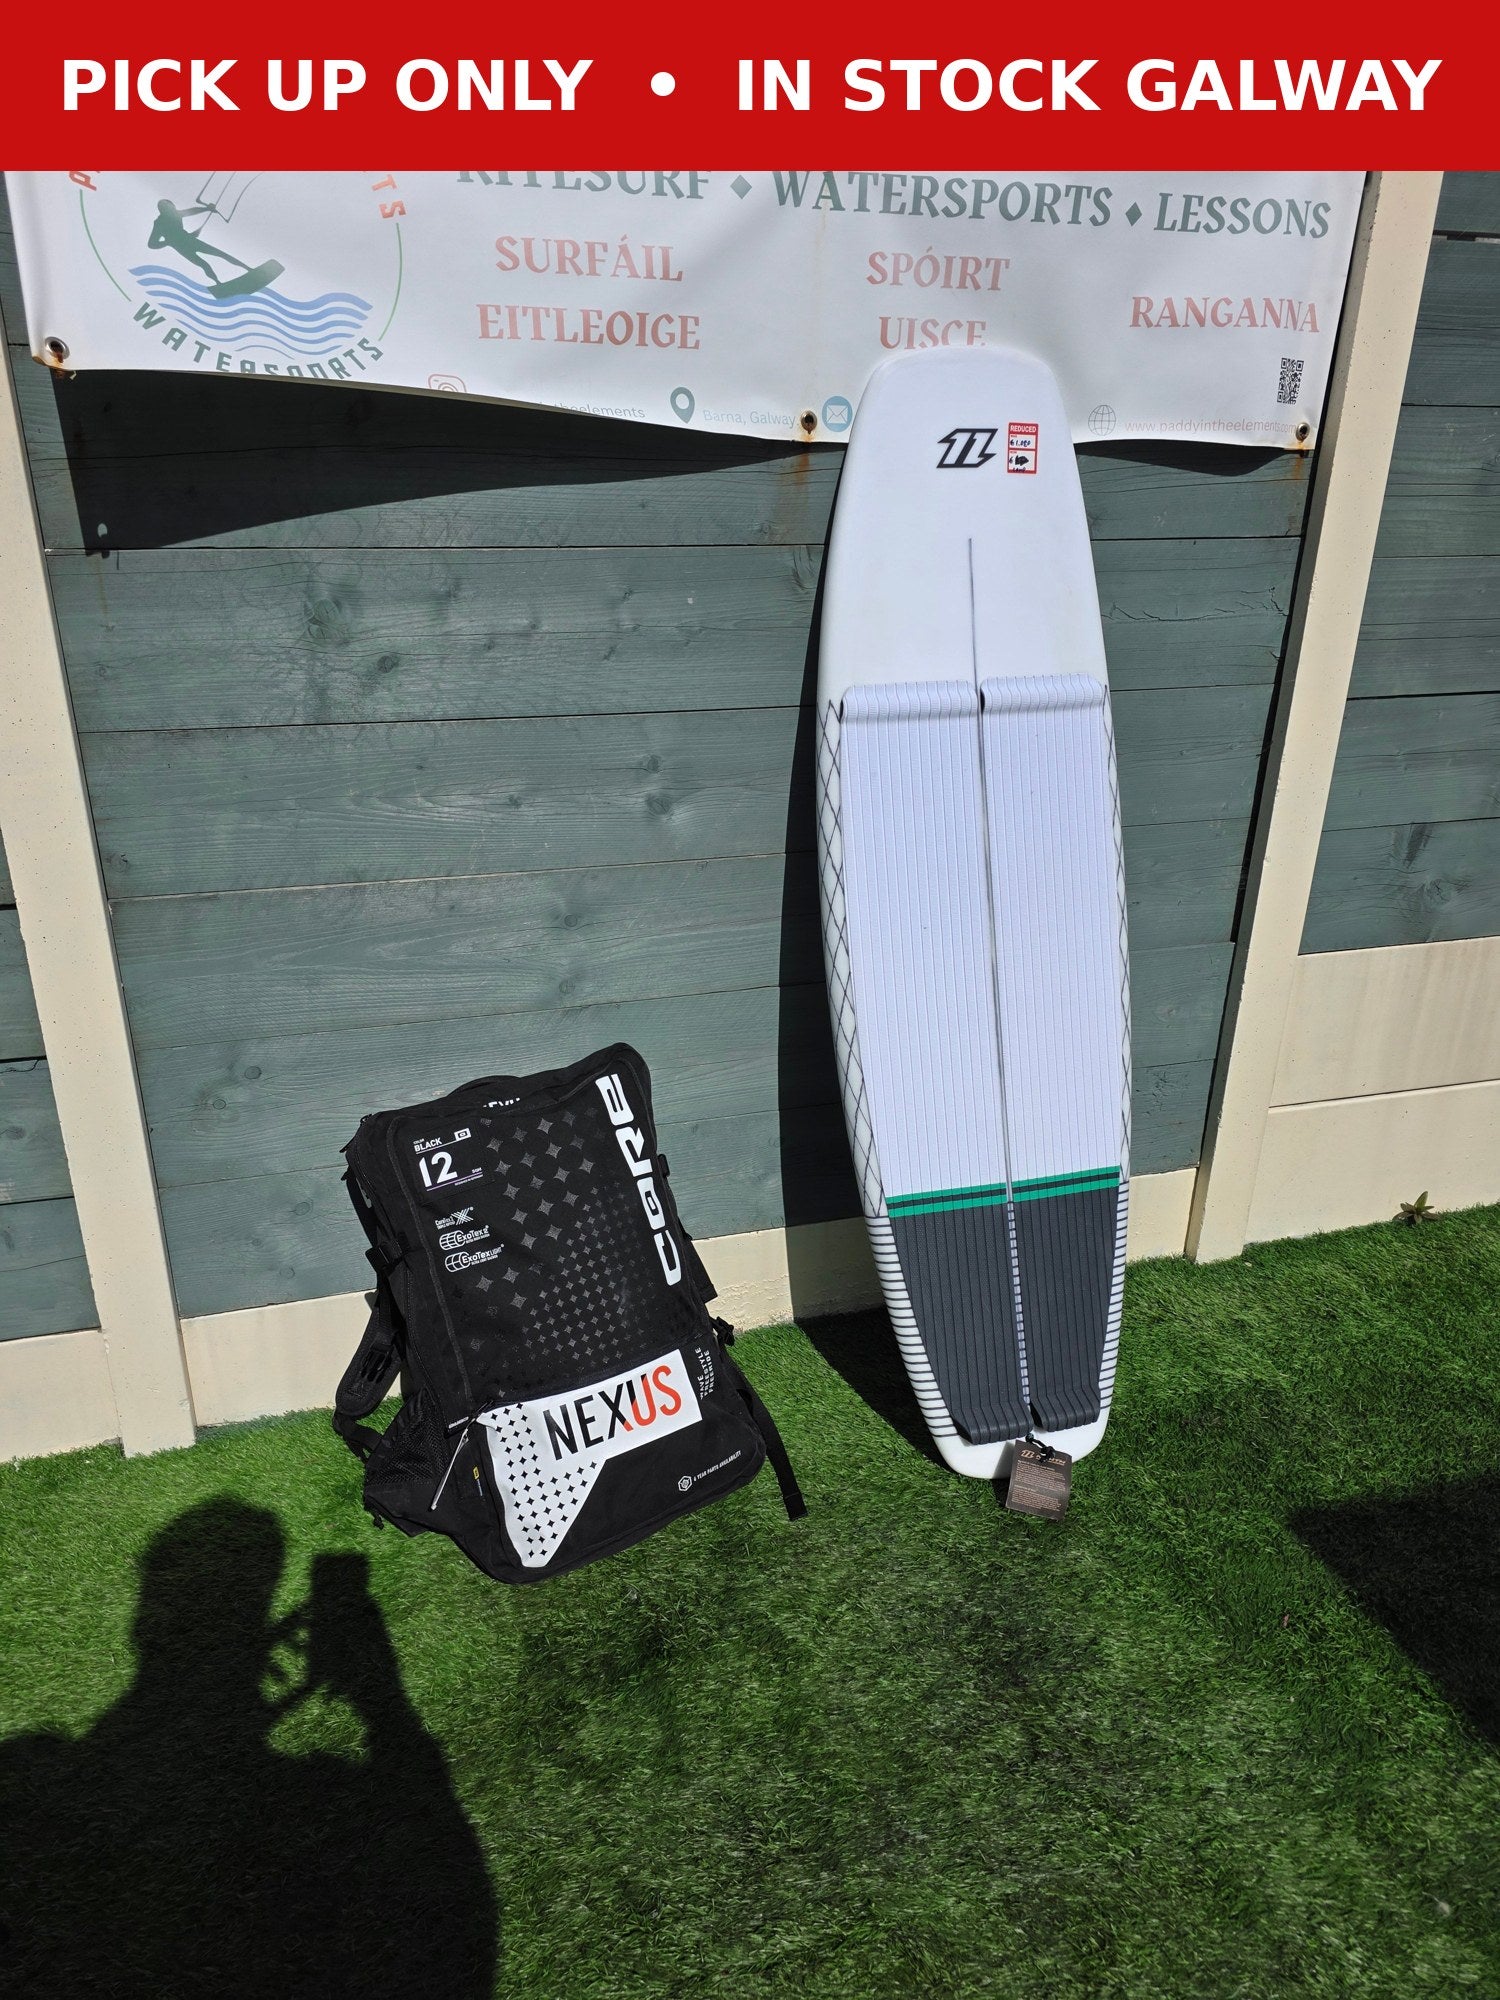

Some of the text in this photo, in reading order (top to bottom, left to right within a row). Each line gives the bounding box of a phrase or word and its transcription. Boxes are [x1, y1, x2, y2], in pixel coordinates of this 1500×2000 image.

[773, 171, 1113, 226] WATERSPORTS
[1154, 193, 1331, 239] LESSONS
[495, 234, 683, 282] SURFÁIL
[866, 246, 1010, 291] SPÓIRT
[476, 304, 700, 350] EITLEOIGE
[879, 316, 987, 350] UISCE
[1130, 296, 1319, 333] RANGANNA
[1010, 425, 1037, 433] REDUCED
[414, 1137, 442, 1152] BLACK
[419, 1151, 458, 1188] 12
[596, 1074, 682, 1287] CORE
[695, 1347, 709, 1396] FREESTYLE
[704, 1350, 714, 1393] FREERIDE
[543, 1365, 682, 1461] NEXUS
